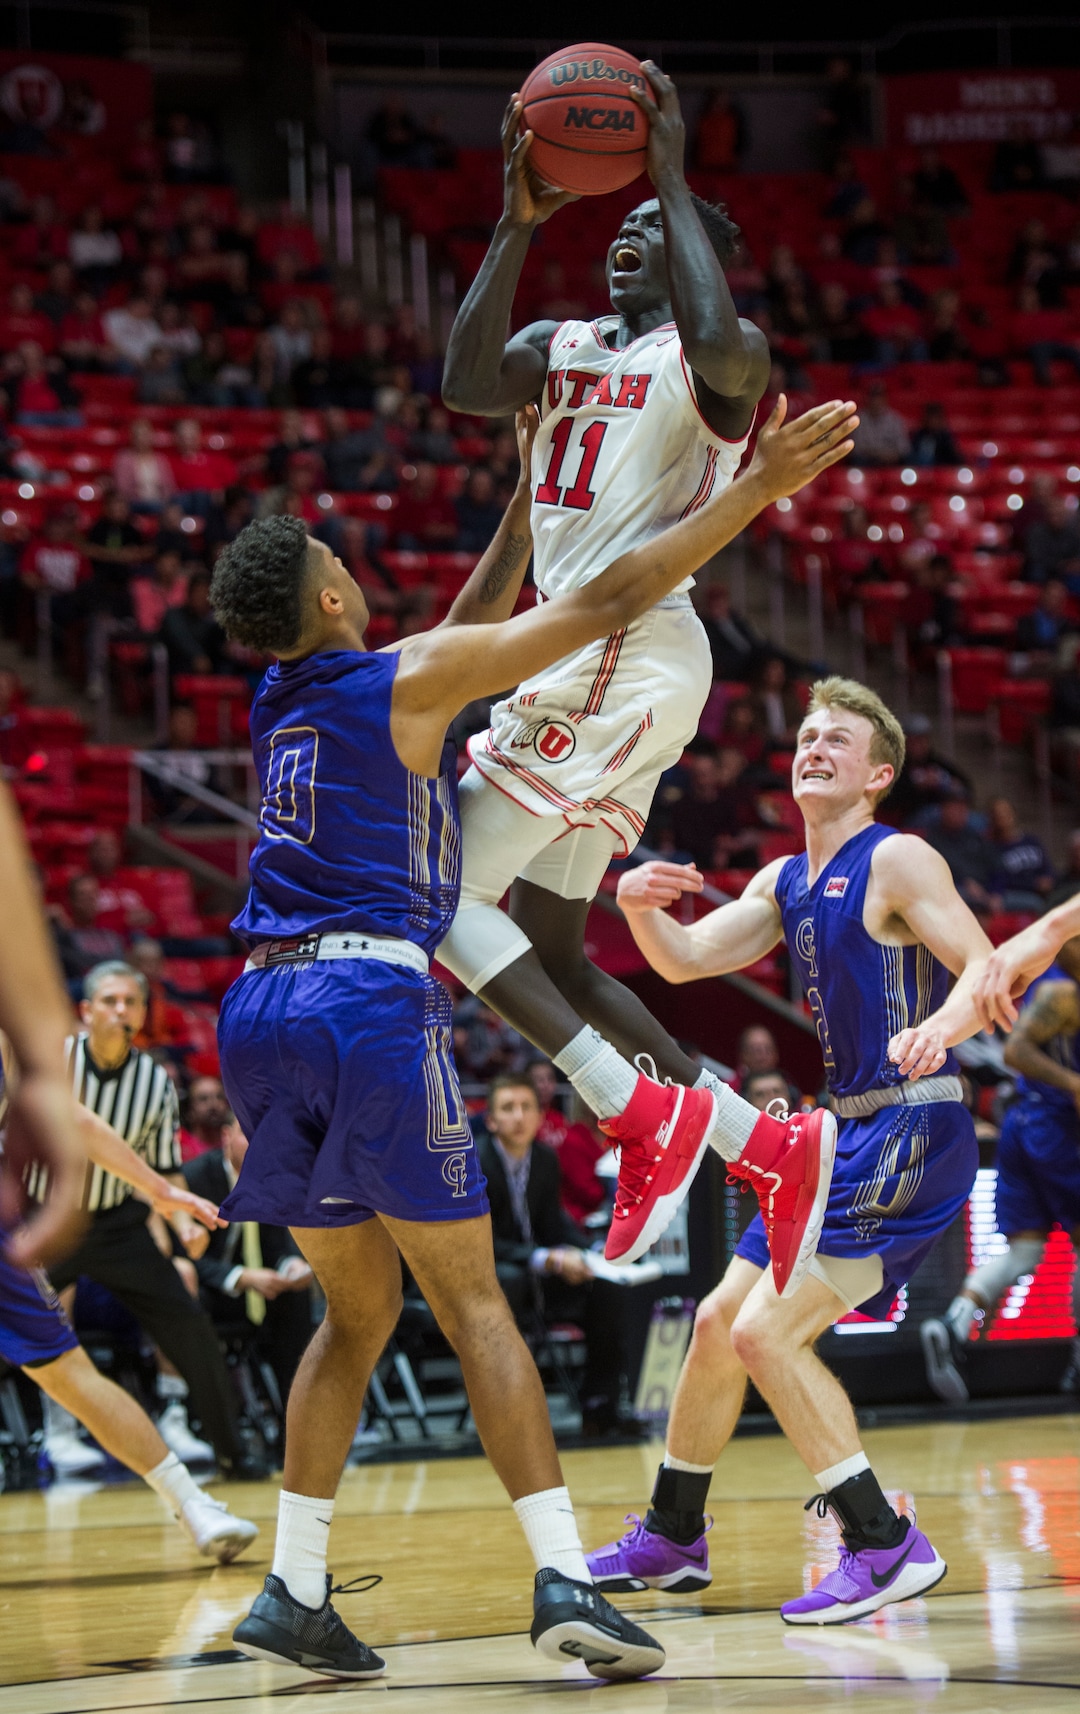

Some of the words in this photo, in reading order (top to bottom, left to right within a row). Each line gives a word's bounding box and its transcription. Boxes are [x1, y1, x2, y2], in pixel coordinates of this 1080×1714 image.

[549, 58, 646, 90] Wilson
[563, 106, 636, 132] NCAA
[547, 368, 653, 410] UTAH
[534, 416, 609, 511] 11
[539, 724, 573, 759] U
[260, 726, 319, 845] 0
